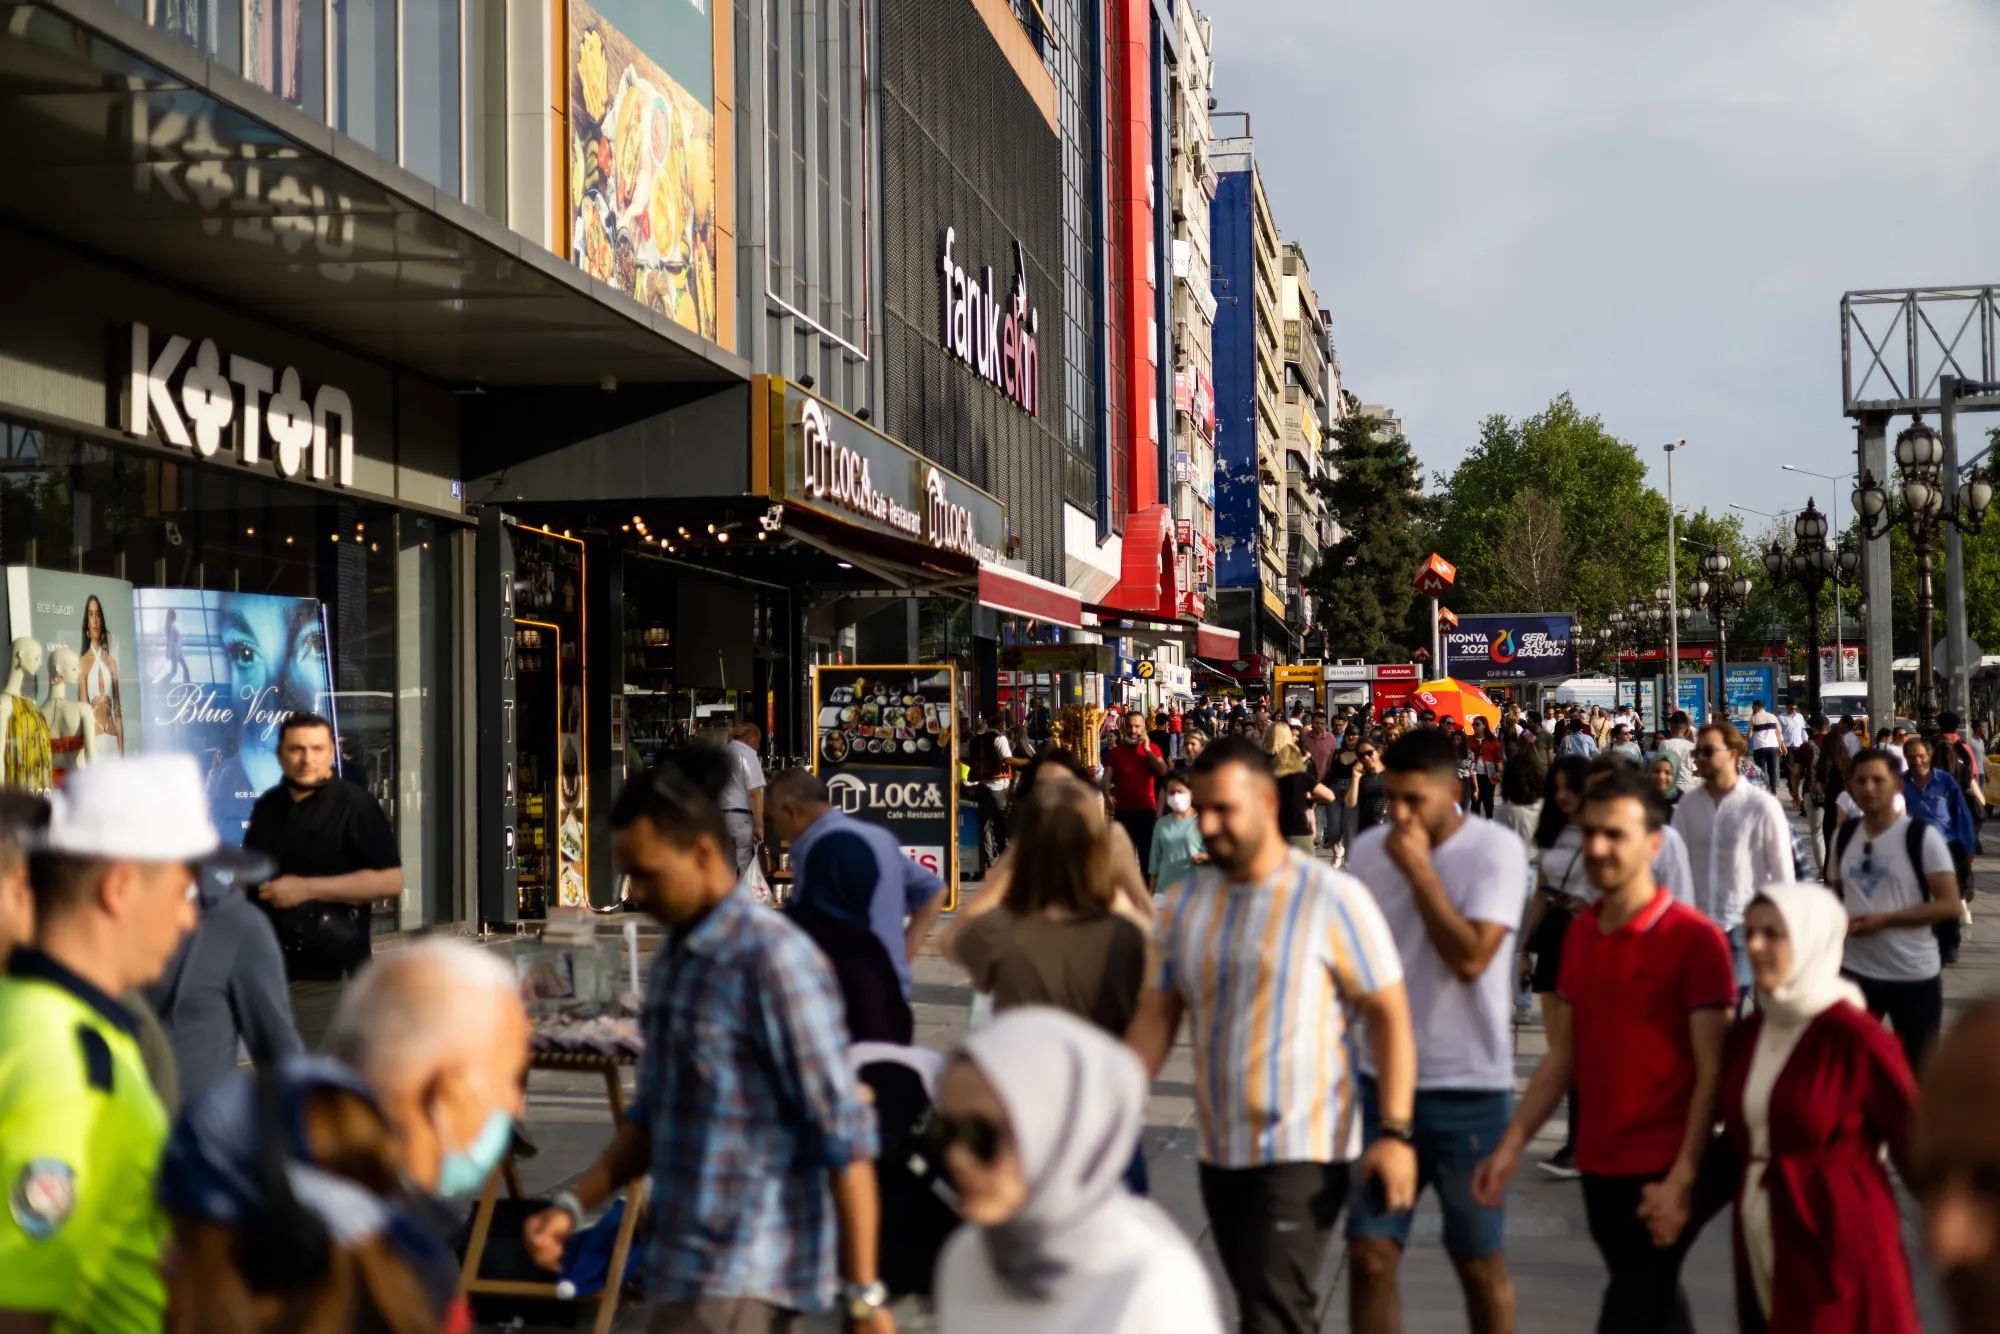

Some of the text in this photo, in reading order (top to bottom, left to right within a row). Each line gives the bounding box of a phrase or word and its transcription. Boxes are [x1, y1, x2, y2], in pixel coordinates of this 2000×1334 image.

[941, 226, 1002, 387] faruk
[131, 321, 353, 486] KOTON
[830, 441, 872, 508] LOCA
[945, 500, 973, 554] LOCA
[1448, 633, 1489, 643] KONYA
[1461, 644, 1489, 654] 2021
[1523, 640, 1558, 650] SAYIM
[154, 683, 234, 725] Blue
[503, 574, 516, 870] AKTAR
[868, 782, 944, 808] LOCA
